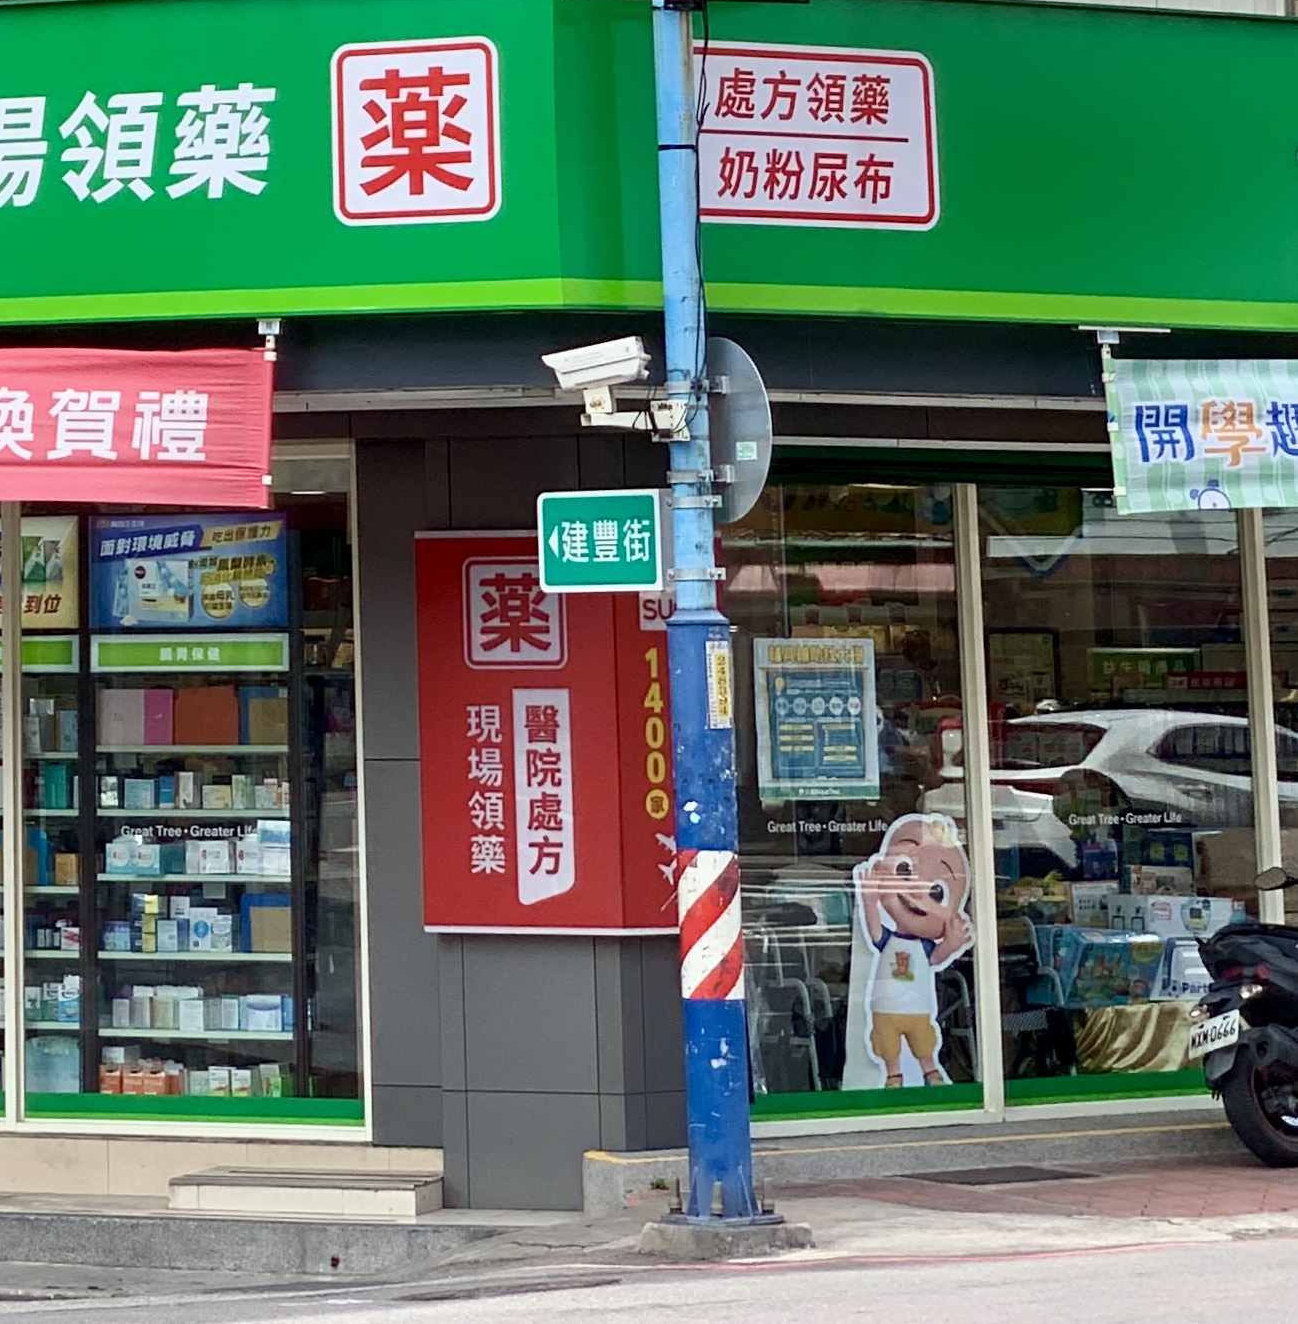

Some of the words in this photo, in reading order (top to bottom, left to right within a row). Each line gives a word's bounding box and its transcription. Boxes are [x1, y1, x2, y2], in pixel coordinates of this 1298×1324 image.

[714, 68, 892, 127] 處方領藥
[717, 147, 895, 205] 奶粉尿布
[561, 518, 651, 564] 建豐街
[467, 704, 506, 875] 現場領藥
[524, 704, 564, 876] 醫院處方
[120, 825, 153, 838] Great
[155, 825, 182, 838] Tree
[190, 825, 235, 838] Greater
[237, 825, 258, 837] Lif
[767, 821, 796, 833] Great
[798, 820, 821, 832] Tree
[828, 820, 867, 832] Greater
[868, 819, 888, 832] Life
[1068, 814, 1096, 825] Great
[1125, 812, 1162, 824] Greater
[1163, 812, 1182, 823] Life
